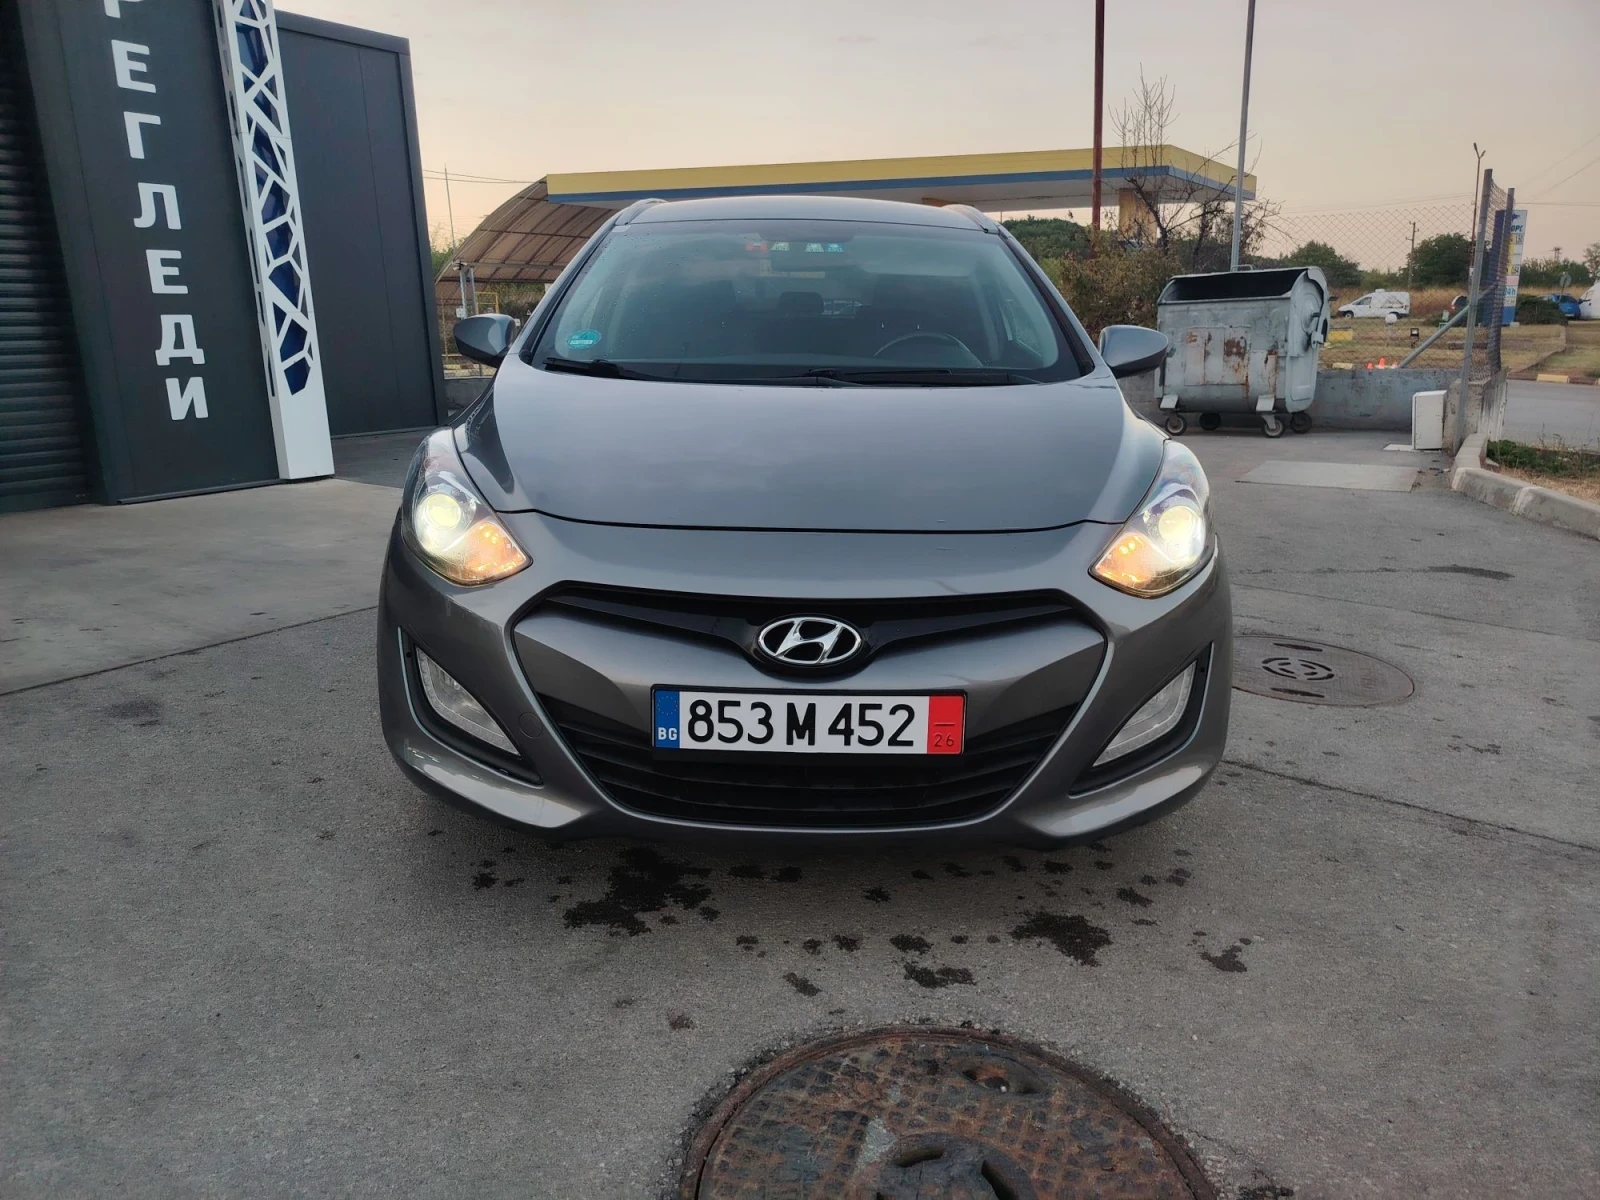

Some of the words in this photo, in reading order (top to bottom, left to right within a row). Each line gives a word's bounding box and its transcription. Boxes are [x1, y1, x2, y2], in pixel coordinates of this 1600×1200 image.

[687, 699, 775, 745] 853
[786, 702, 817, 746] M
[828, 702, 916, 747] 452
[658, 726, 678, 741] BG
[933, 732, 955, 748] 26
